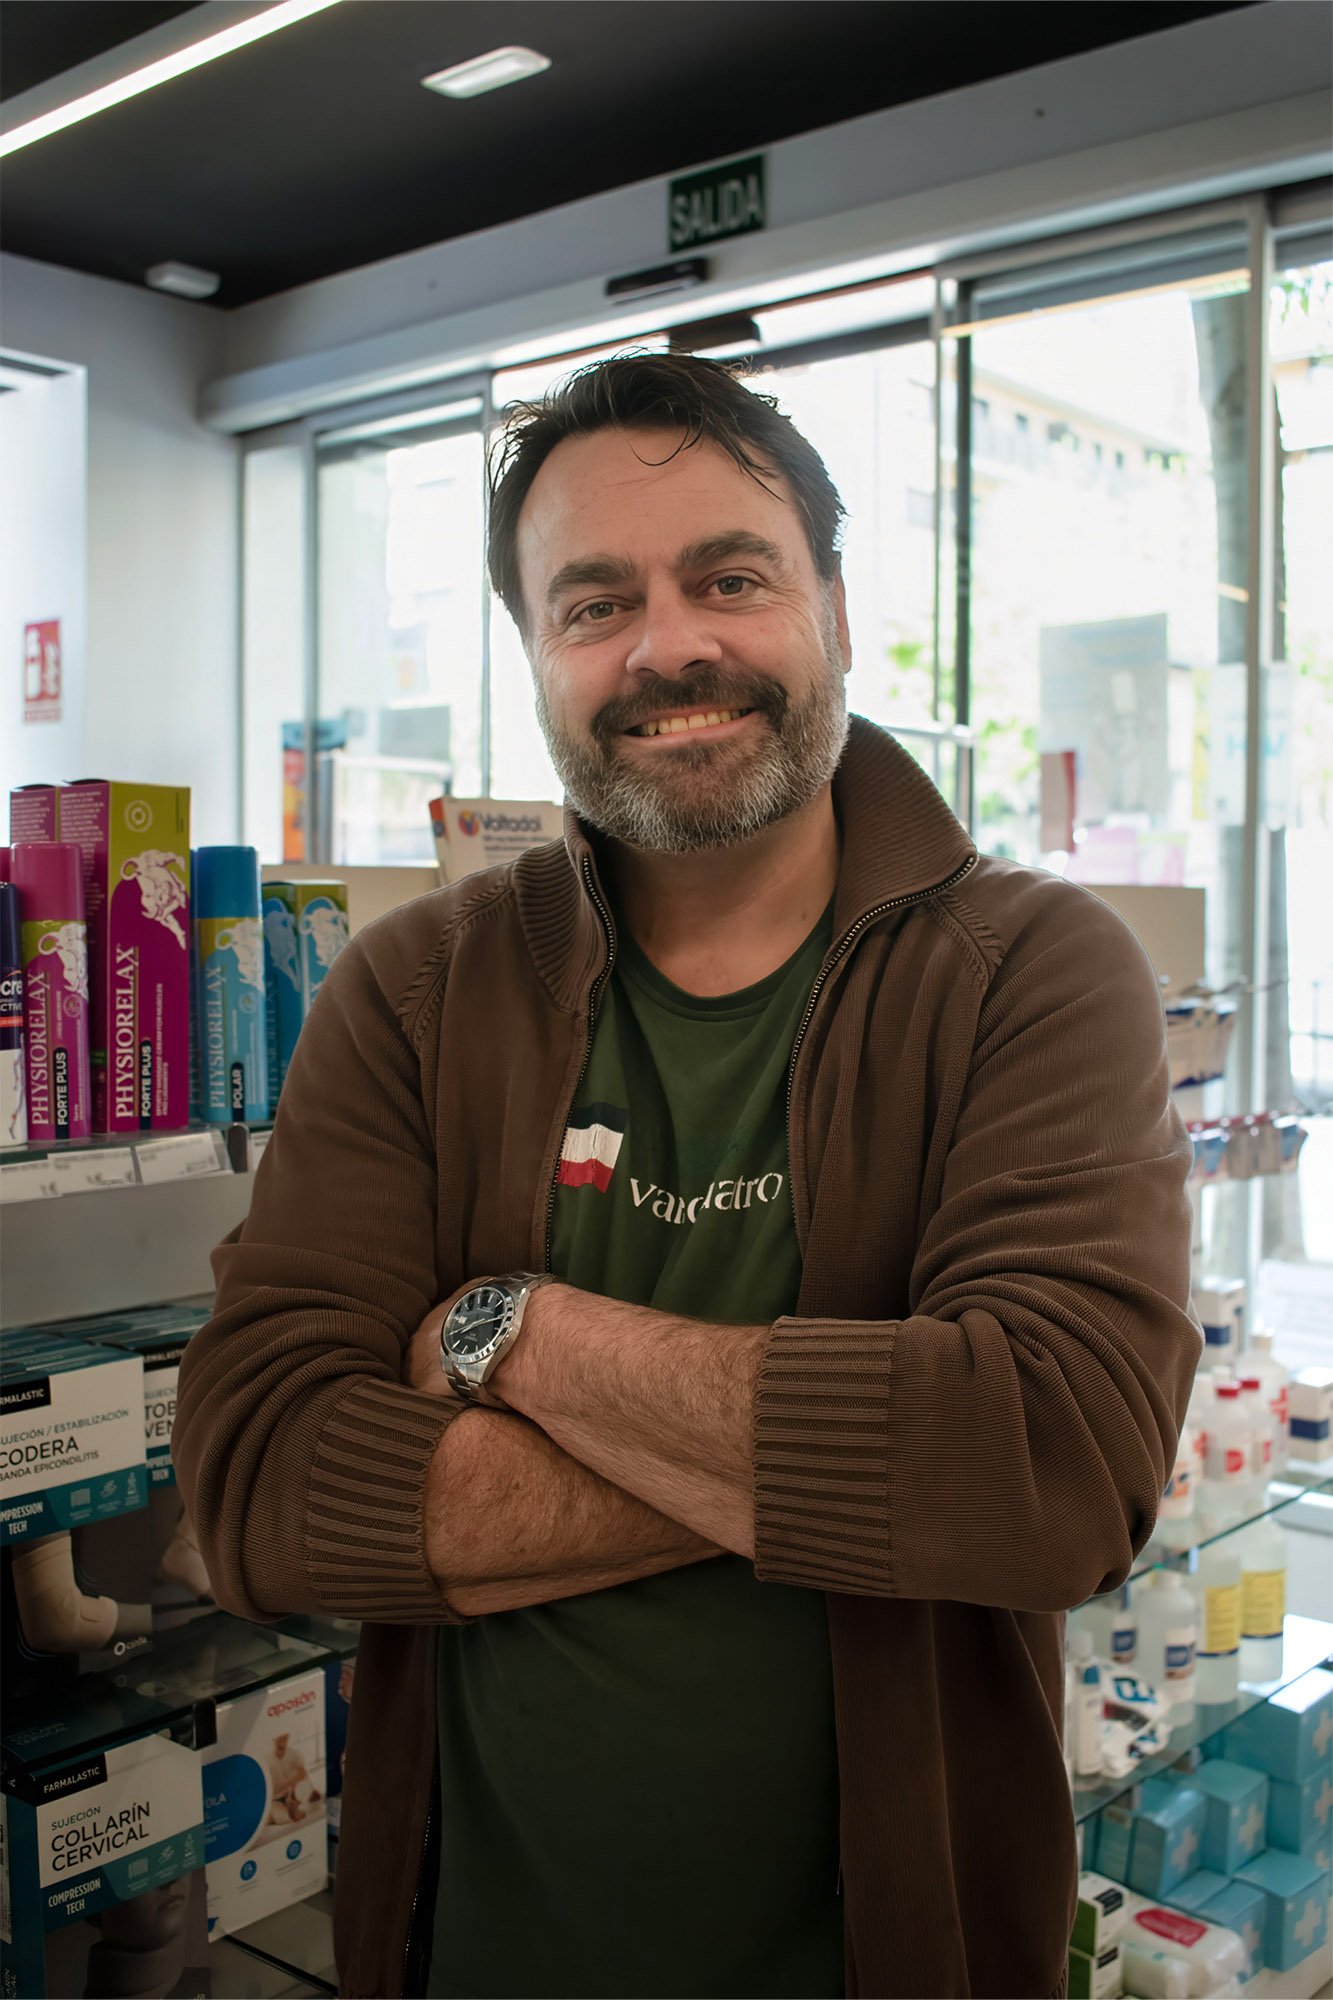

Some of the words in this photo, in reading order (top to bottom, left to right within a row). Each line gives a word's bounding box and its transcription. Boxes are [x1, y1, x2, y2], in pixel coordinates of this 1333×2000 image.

[672, 174, 761, 245] SALIDA
[27, 972, 50, 1125] PHYSIORELAX
[116, 946, 139, 1118] PHYSIORELAX
[206, 966, 226, 1108] PHYSIORELAX
[56, 1052, 67, 1083] PLUS
[141, 1045, 151, 1075] PLUS
[141, 1082, 151, 1117] FORTE
[232, 1069, 243, 1109] POLAR
[57, 1086, 68, 1126] FORTE
[0, 1428, 44, 1446] UJECIÓN
[54, 1408, 129, 1434] ESTABILIZACIÓN
[0, 1436, 79, 1468] CODERA
[34, 1450, 99, 1474] EPICONDILITIS
[0, 1501, 43, 1523] MPRESSION
[8, 1520, 28, 1535] TECH
[43, 1766, 100, 1794] FARMALASTIC
[51, 1805, 101, 1831] SUJECIÓN
[51, 1801, 151, 1852] COLLARÍN
[51, 1825, 149, 1872] CERVICAL
[48, 1878, 101, 1908] COMPRESSION
[66, 1899, 85, 1915] TECH
